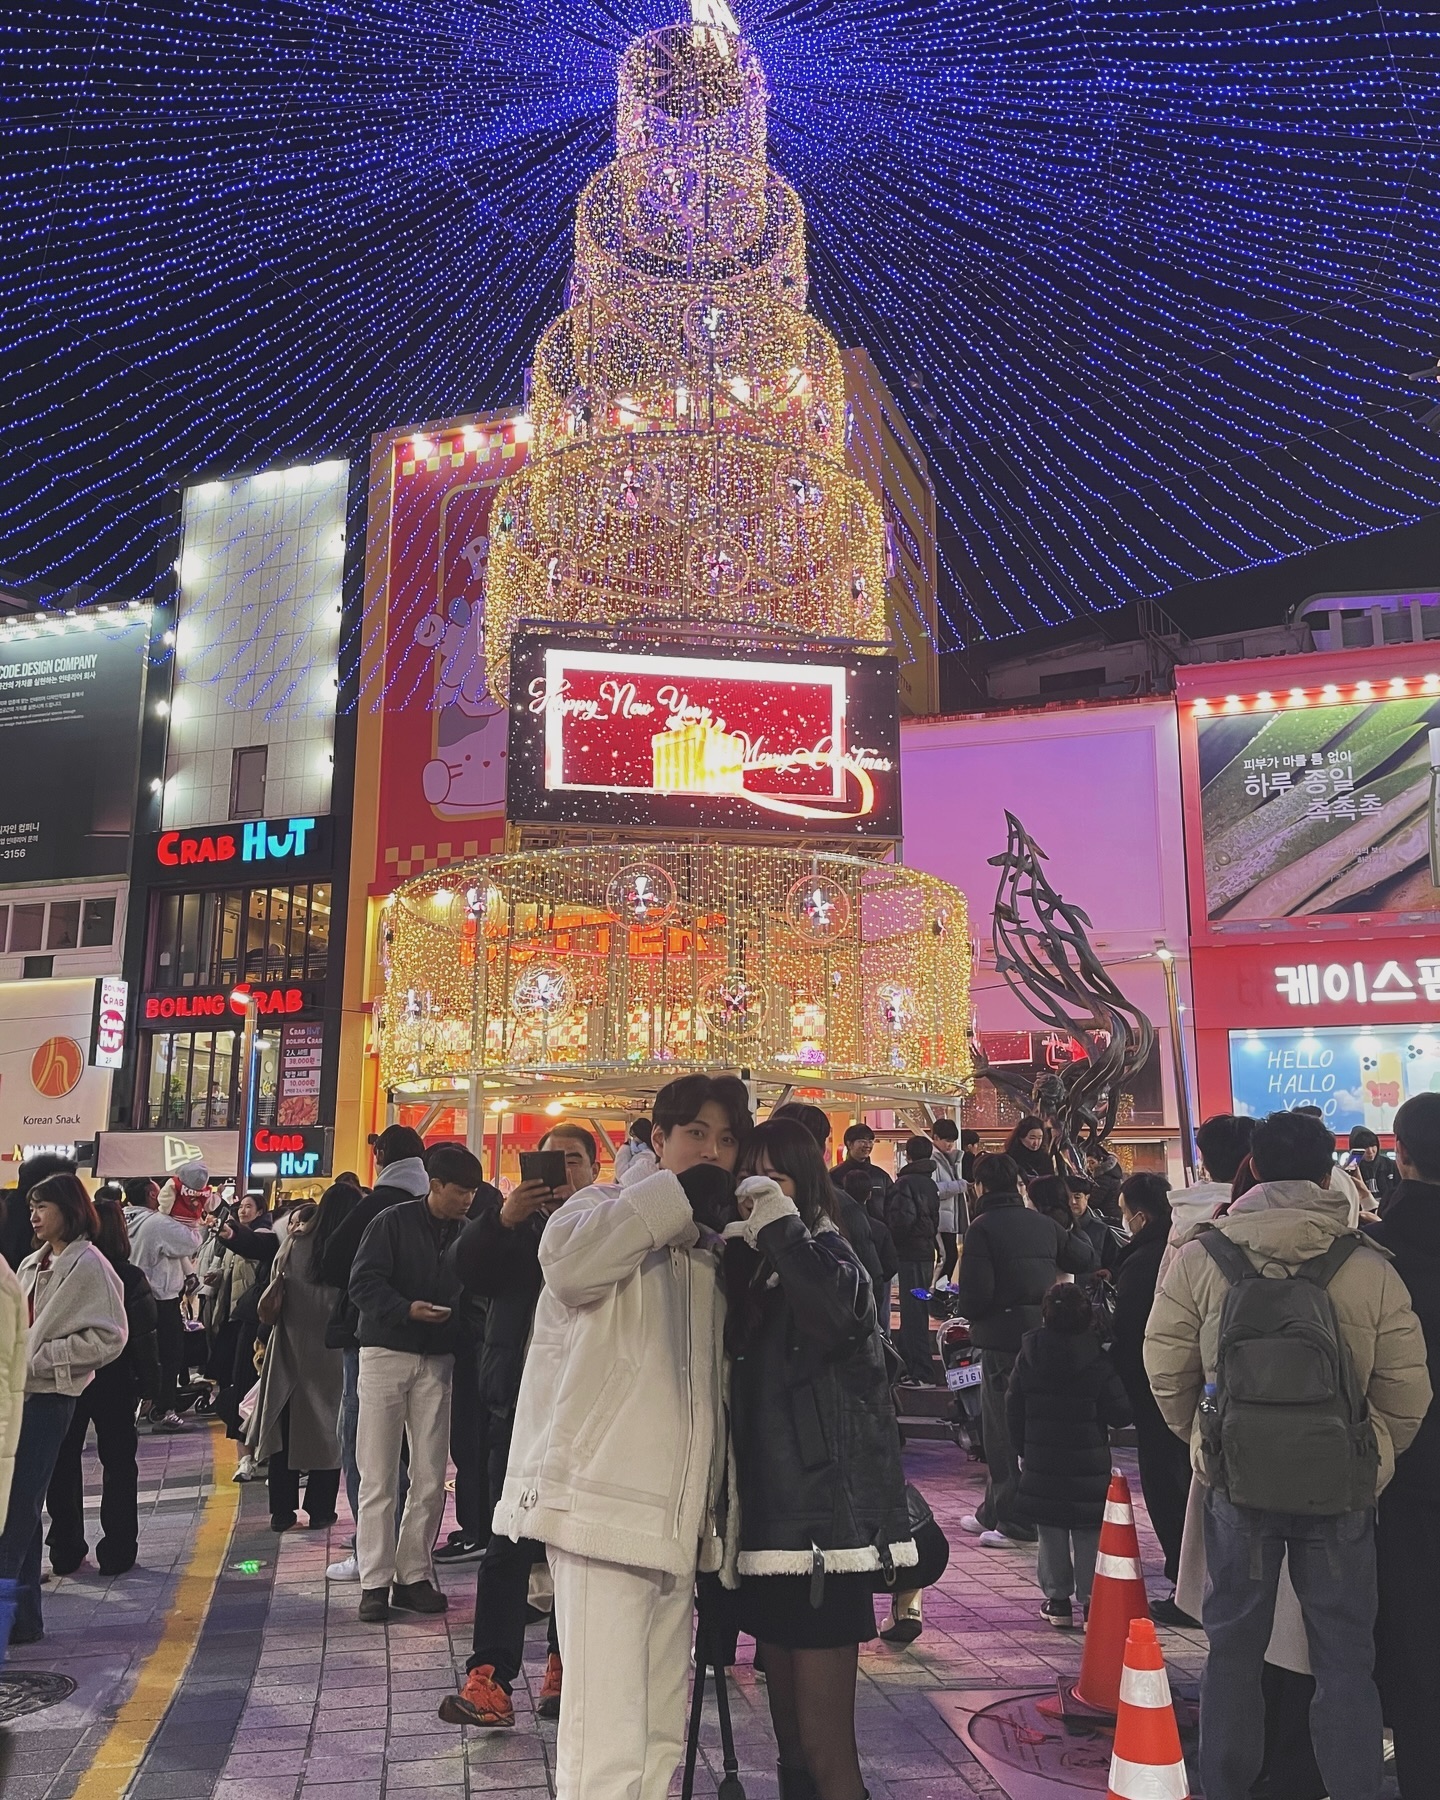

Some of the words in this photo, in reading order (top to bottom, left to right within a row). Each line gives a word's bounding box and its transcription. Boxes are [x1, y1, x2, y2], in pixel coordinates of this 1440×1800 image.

[54, 653, 98, 673] COMPANY
[528, 677, 608, 721] Happy
[600, 680, 654, 719] New
[657, 685, 712, 721] Year
[730, 730, 800, 774] Merry
[793, 735, 892, 771] Chstmas
[1243, 757, 1279, 770] 피부가
[1283, 754, 1307, 768] 마를
[1327, 750, 1352, 764] 없이
[1244, 772, 1295, 798] 하루
[1303, 766, 1355, 794] 종일
[1307, 794, 1385, 822] 촉촉촉
[18, 821, 40, 833] 컴퍼니
[0, 848, 26, 859] -3156
[157, 831, 236, 866] CRAB
[103, 993, 124, 1007] CRAB
[145, 994, 225, 1018] BOILING
[230, 983, 303, 1016] CRAB
[1267, 1049, 1333, 1069] HELLO
[1268, 1073, 1336, 1094] HALLO
[23, 1115, 52, 1125] Korean
[55, 1114, 80, 1125] Snack
[255, 1130, 304, 1151] CRAB
